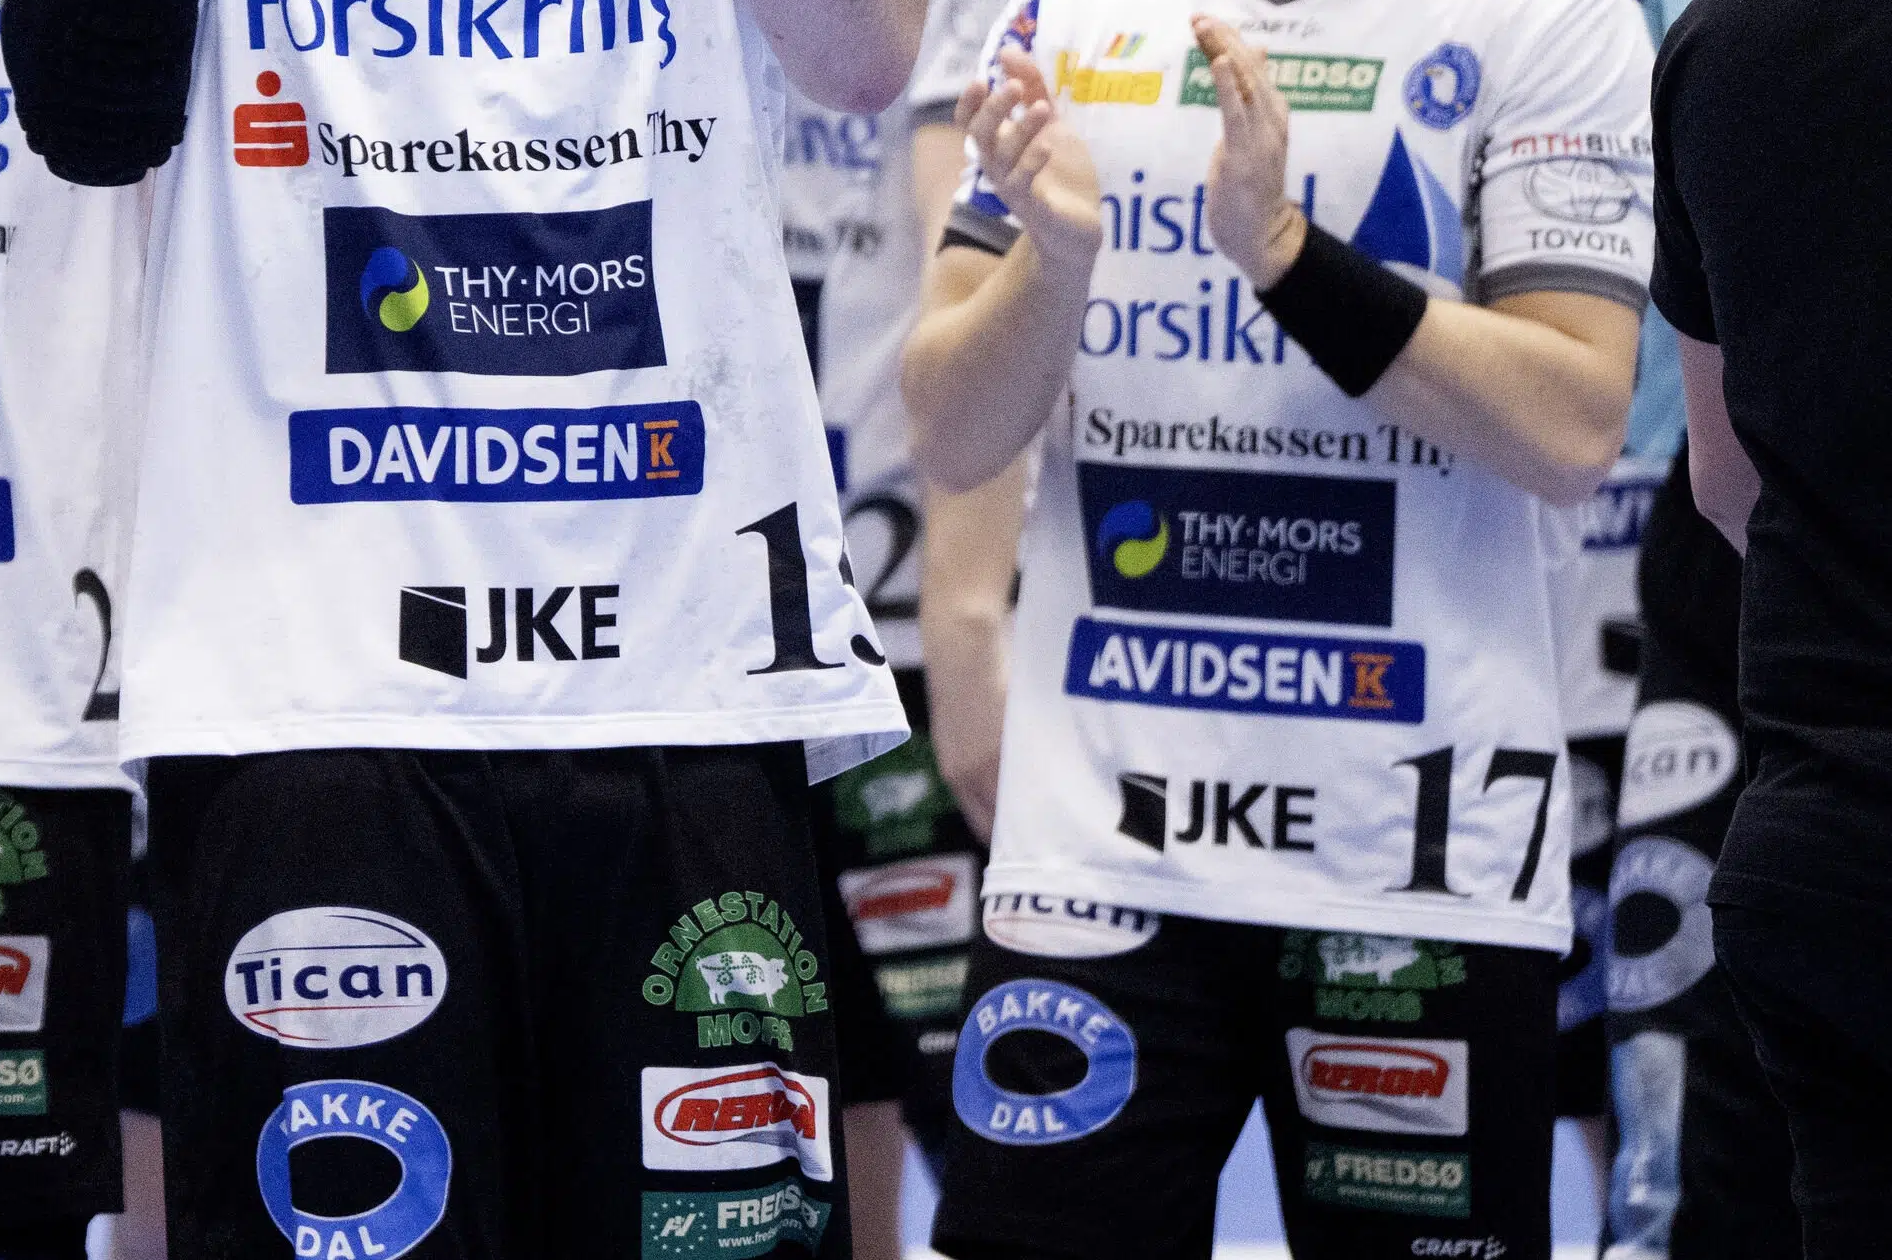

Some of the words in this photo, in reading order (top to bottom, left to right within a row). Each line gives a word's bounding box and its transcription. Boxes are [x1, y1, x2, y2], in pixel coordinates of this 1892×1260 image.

[318, 121, 643, 177] Sparekassen
[1528, 228, 1634, 258] TOYOTA
[449, 300, 591, 337] ENERGI
[1078, 277, 1288, 367] orsik
[328, 421, 640, 487] DAVIDSEN
[1085, 407, 1369, 463] Sparekassen
[734, 500, 888, 677] 1
[1181, 546, 1309, 586] ENERGI
[475, 584, 621, 666] JKE
[1088, 636, 1343, 707] AVIDSEN
[1173, 778, 1316, 852] JKE
[1383, 745, 1558, 902] 17
[642, 890, 829, 1015] ORNESTATION
[235, 956, 435, 1006] Tican
[977, 991, 1109, 1046] BAKKE
[279, 1092, 418, 1145] AKKE
[989, 1103, 1067, 1136] DAL
